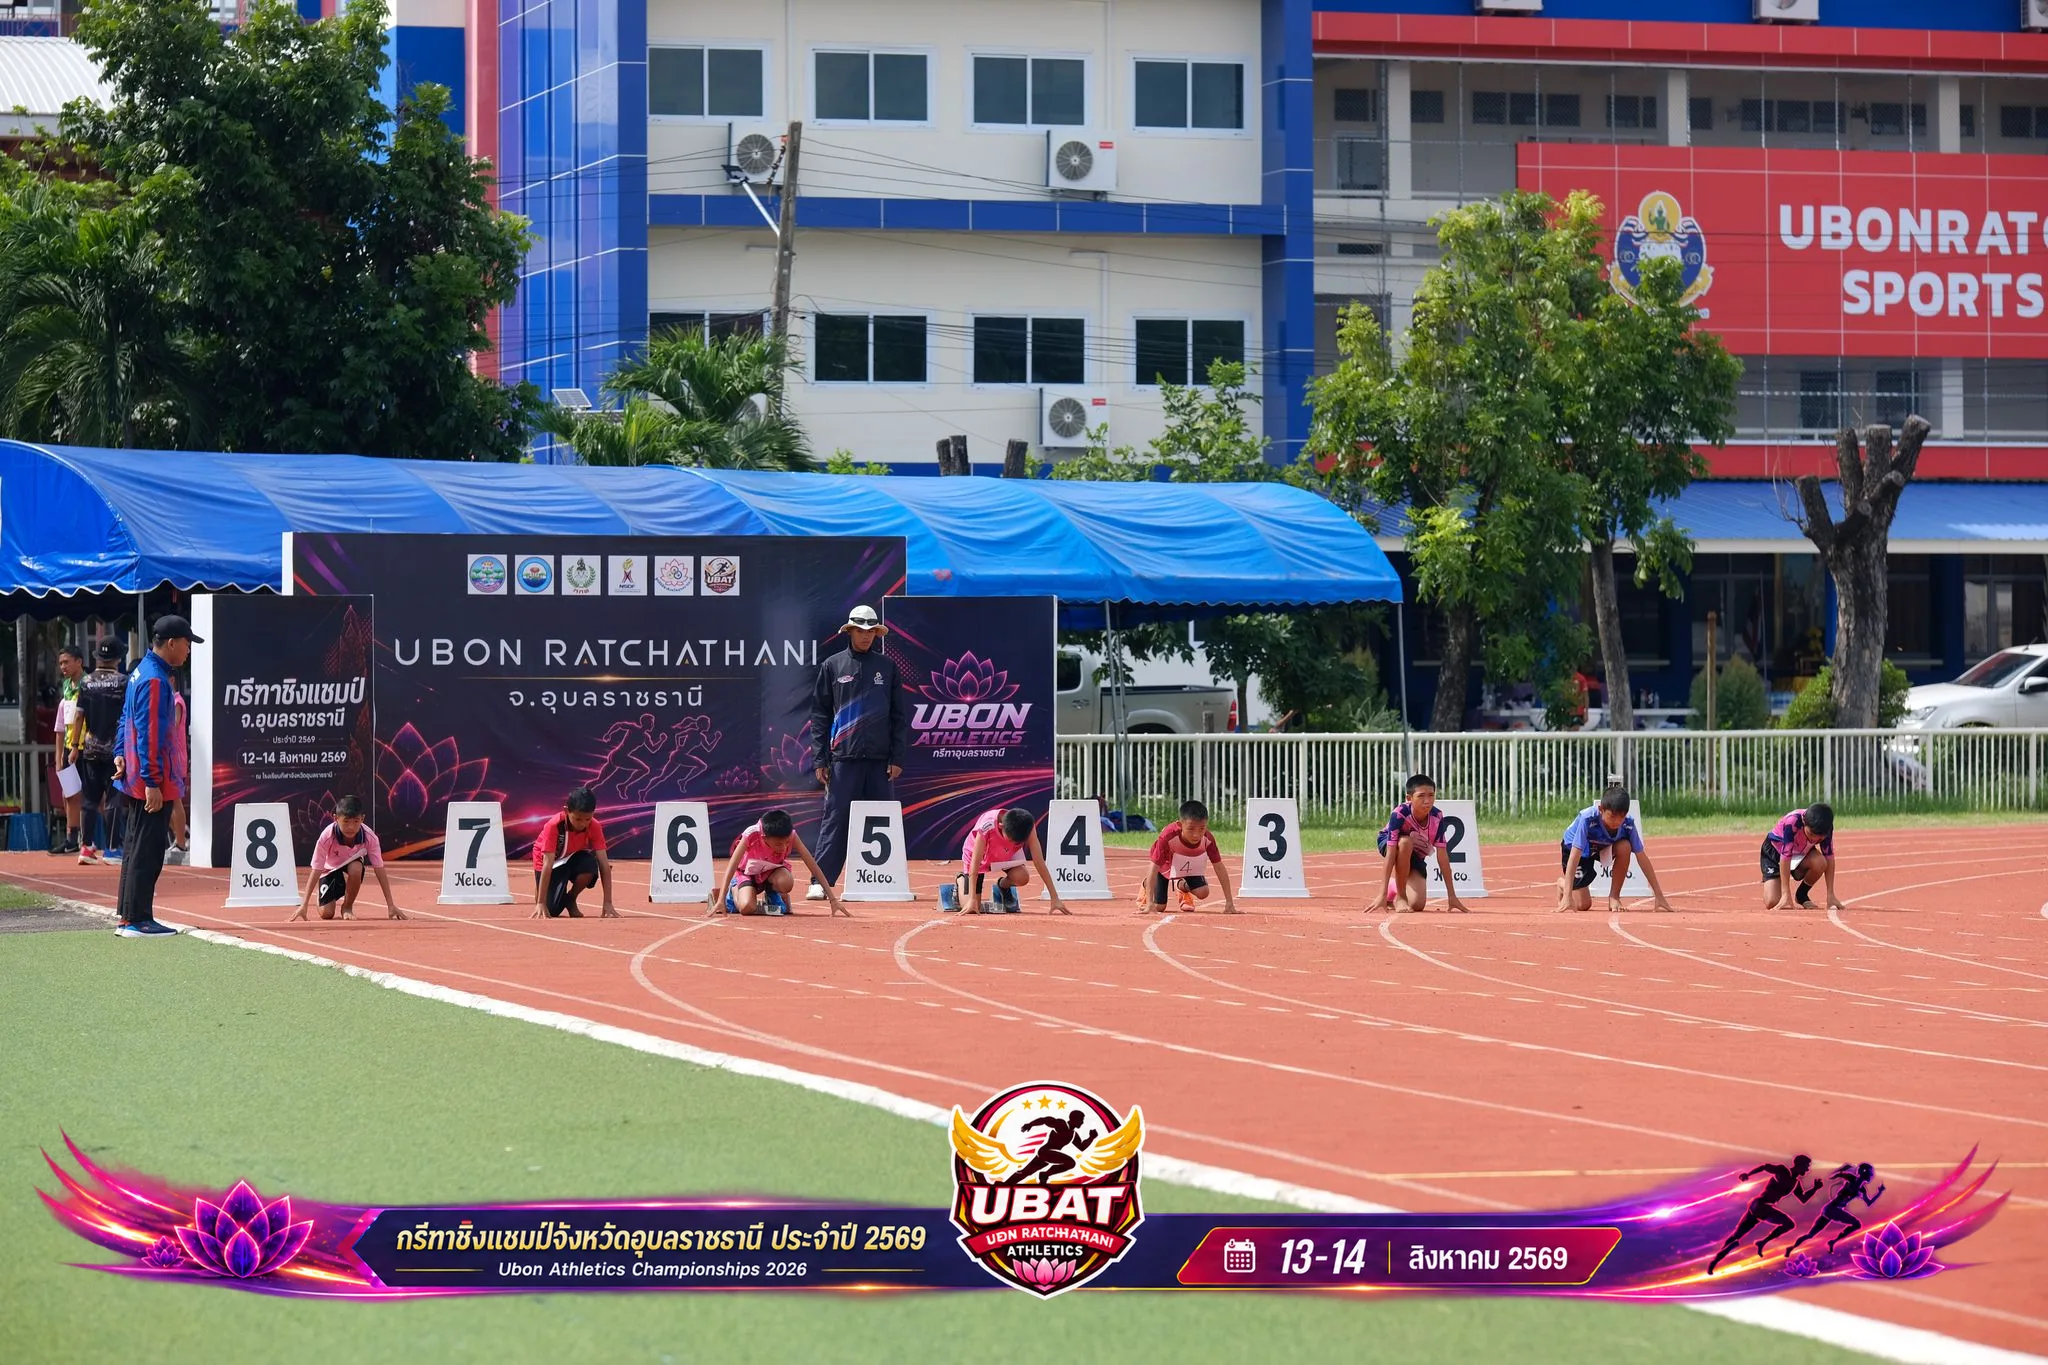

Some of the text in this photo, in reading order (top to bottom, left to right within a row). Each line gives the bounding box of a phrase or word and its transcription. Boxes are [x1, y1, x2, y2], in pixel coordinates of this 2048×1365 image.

[1779, 204, 2048, 255] UBONRAT
[1843, 269, 2045, 318] SPORTS
[707, 576, 732, 584] UBAT
[395, 638, 818, 666] UBON RATCHATHANI
[911, 703, 1033, 730] UBON
[298, 735, 316, 744] 2569
[912, 730, 1028, 747] ATHLETICS
[279, 751, 318, 764] สิงหาคม
[320, 751, 347, 763] 2569
[246, 818, 278, 869] 8
[458, 818, 491, 869] 7
[667, 815, 698, 865] 6
[861, 816, 892, 866] 5
[1060, 815, 1091, 865] 4
[1258, 813, 1288, 862] 3
[1442, 815, 1466, 863] 2
[241, 873, 281, 888] Nelco
[454, 872, 493, 887] Nelco
[662, 868, 700, 884] Nelco
[856, 869, 893, 884] Nelco
[1056, 868, 1092, 882] Nelco
[1433, 868, 1468, 882] Nco
